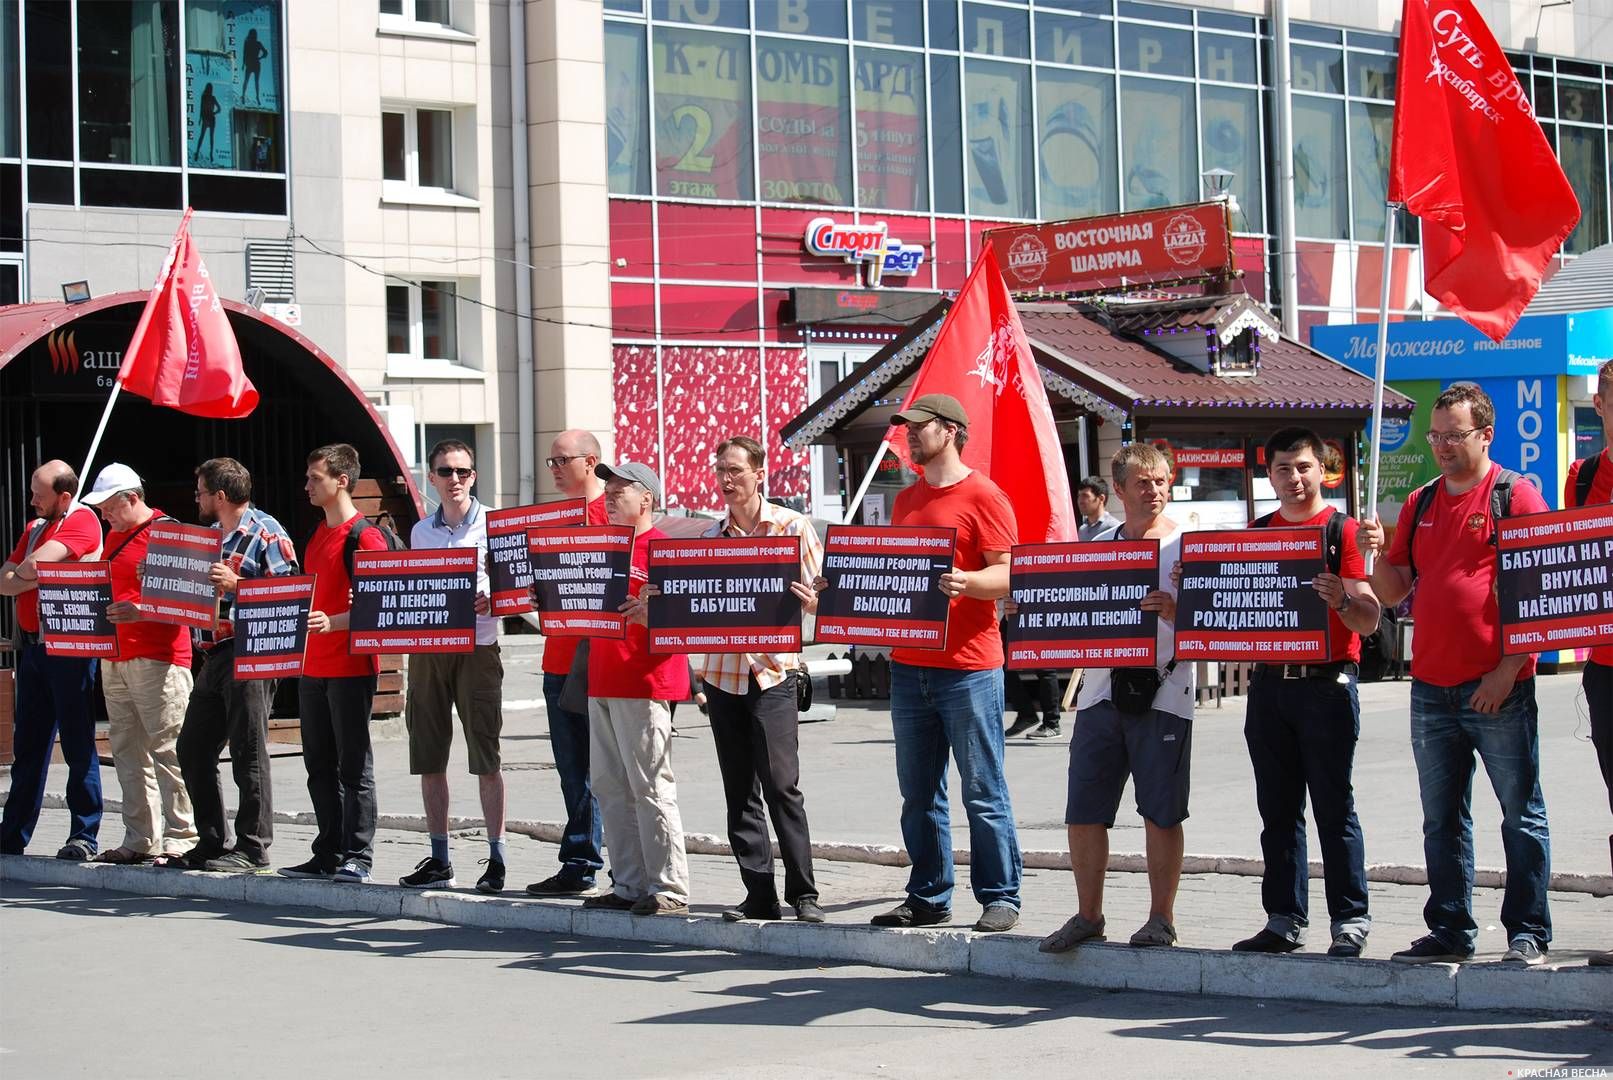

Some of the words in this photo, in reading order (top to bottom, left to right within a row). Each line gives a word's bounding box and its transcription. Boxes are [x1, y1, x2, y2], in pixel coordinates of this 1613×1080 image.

[1433, 10, 1484, 69] Суть
[186, 63, 194, 140] АТЕЛЬЕ
[673, 105, 715, 173] 2
[670, 180, 717, 198] этаж
[812, 225, 884, 257] Спорт
[1055, 222, 1153, 250] ВОСТОЧНАЯ
[1164, 230, 1206, 248] LAZZAT
[1008, 252, 1048, 267] LAZZAT
[1070, 249, 1142, 273] ШАУРМА
[1343, 336, 1466, 359] Мооженое
[1177, 451, 1219, 463] БАКИНСКИЙ
[1221, 453, 1245, 463] ДОНЕР
[490, 520, 505, 528] НАРОД
[1502, 527, 1529, 540] НАРОД
[1530, 523, 1564, 537] ГОВОРИТ
[1566, 521, 1571, 532] О
[490, 534, 528, 549] ПОВЫСИТ
[830, 536, 849, 545] НАРОД
[850, 537, 875, 545] ГОВОРИТ
[920, 538, 950, 547] РЕФОРМЕ
[1205, 543, 1235, 552] ГОВОРИТ
[1237, 543, 1241, 552] О
[1283, 540, 1317, 551] РЕФОРМЕ
[494, 548, 528, 562] ВОЗРАСТ
[560, 552, 606, 565] ПОДДЕРЖКА
[653, 550, 675, 559] НАРОД
[677, 549, 706, 558] ГОВОРИТ
[708, 548, 712, 557] О
[760, 547, 795, 556] РЕФОРМЕ
[1034, 555, 1065, 564] ГОВОРИТ
[1066, 555, 1070, 563] О
[1118, 551, 1153, 561] РЕФОРМЕ
[1502, 545, 1576, 570] БАБУШКА
[1581, 542, 1600, 561] НА
[146, 553, 187, 570] ПОЗОРНАЯ
[357, 561, 376, 569] НАРОД
[378, 560, 402, 568] ГОВОРИТ
[446, 557, 473, 566] РЕФОРМЕ
[510, 564, 515, 574] С
[517, 562, 526, 573] 55
[827, 556, 885, 569] ПЕНСИОННАЯ
[887, 558, 930, 570] РЕФОРМА
[1220, 562, 1278, 575] ПОВЫШЕНИЕ
[535, 566, 584, 580] ПЕНСИОННОЙ
[1542, 566, 1607, 590] ВНУКАМ
[358, 581, 405, 592] РАБОТАТЬ
[408, 580, 414, 591] И
[417, 578, 471, 590] ОТЧИСЛЯТЬ
[664, 579, 722, 594] ВЕРНИТЕ
[726, 578, 784, 593] ВНУКАМ
[838, 574, 929, 593] АНТИНАРОДНАЯ
[1183, 577, 1250, 590] ПЕНСИОННОГО
[1253, 576, 1298, 589] ВОЗРАСТА
[382, 595, 397, 608] НА
[400, 593, 446, 607] ПЕНСИЮ
[561, 599, 587, 610] ПЯТНО
[691, 597, 756, 612] БАБУШЕК
[853, 596, 911, 615] ВЫХОДКА
[1213, 591, 1284, 608] СНИЖЕНИЕ
[1518, 595, 1598, 618] НАЁМНУЮ
[47, 618, 60, 629] ЧТО
[62, 618, 94, 631] ДАЛЬШЕ?
[378, 612, 393, 627] ДО
[397, 611, 449, 625] СМЕРТИ?
[1019, 614, 1025, 628] А
[1029, 613, 1043, 627] НЕ
[1046, 612, 1088, 627] КРАЖА
[1092, 608, 1141, 626] ПЕНСИЙ!
[1193, 610, 1298, 630] РОЖДАЕМОСТИ
[248, 622, 267, 637] УДАР
[269, 621, 277, 633] ПО
[886, 628, 900, 637] ТЕБЕ
[901, 629, 908, 638] НЕ
[1510, 631, 1545, 645] ВЛАСТЬ,
[1548, 625, 1596, 640] ОПОМНИСЬ!
[247, 639, 252, 651] И
[442, 637, 470, 645] ПРОСТЯТ!
[655, 637, 684, 646] ВЛАСТЬ,
[731, 636, 746, 644] ТЕБЕ
[749, 635, 757, 644] НЕ
[759, 635, 794, 644] ПРОСТЯТ!
[1209, 641, 1254, 650] ОПОМНИСЬ!
[1256, 641, 1271, 650] ТЕБЕ
[1274, 641, 1282, 650] НЕ
[1283, 641, 1319, 650] ПРОСТЯТ!
[1086, 649, 1102, 658] ТЕБЕ
[1104, 649, 1112, 658] НЕ
[1114, 648, 1148, 657] ПРОСТЯТ!
